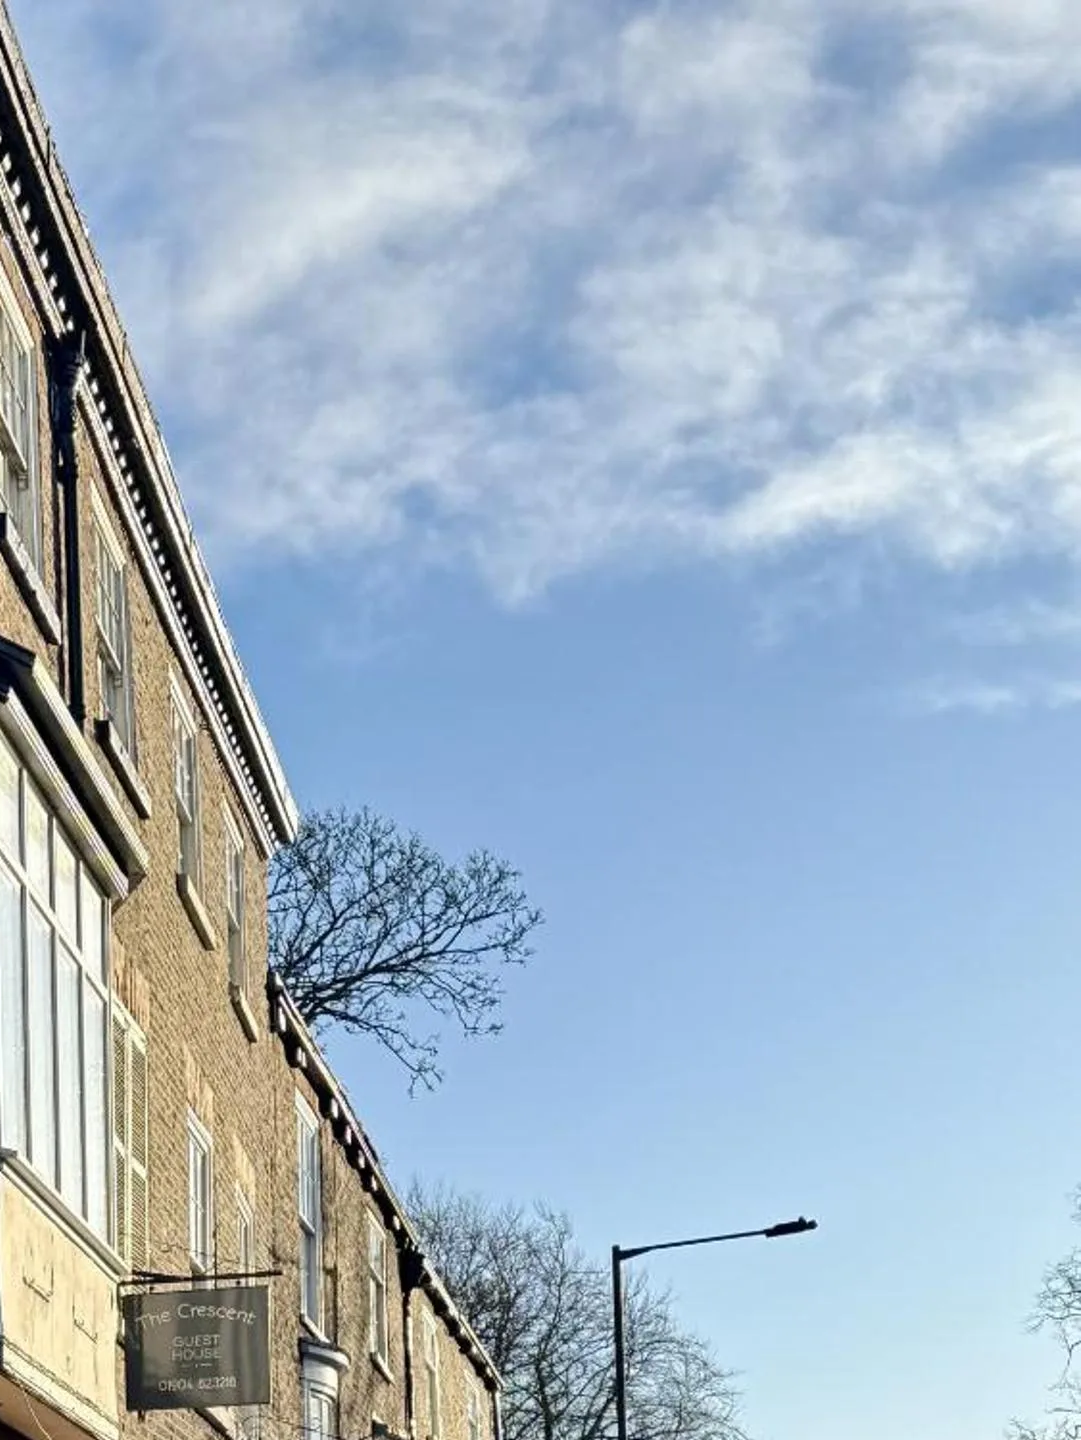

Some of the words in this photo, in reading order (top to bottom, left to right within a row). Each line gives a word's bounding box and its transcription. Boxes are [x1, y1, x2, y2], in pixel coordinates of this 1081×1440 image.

[135, 1311, 172, 1328] The
[177, 1303, 257, 1325] Crescent
[173, 1334, 221, 1347] GUEST
[171, 1347, 222, 1361] HOUSE
